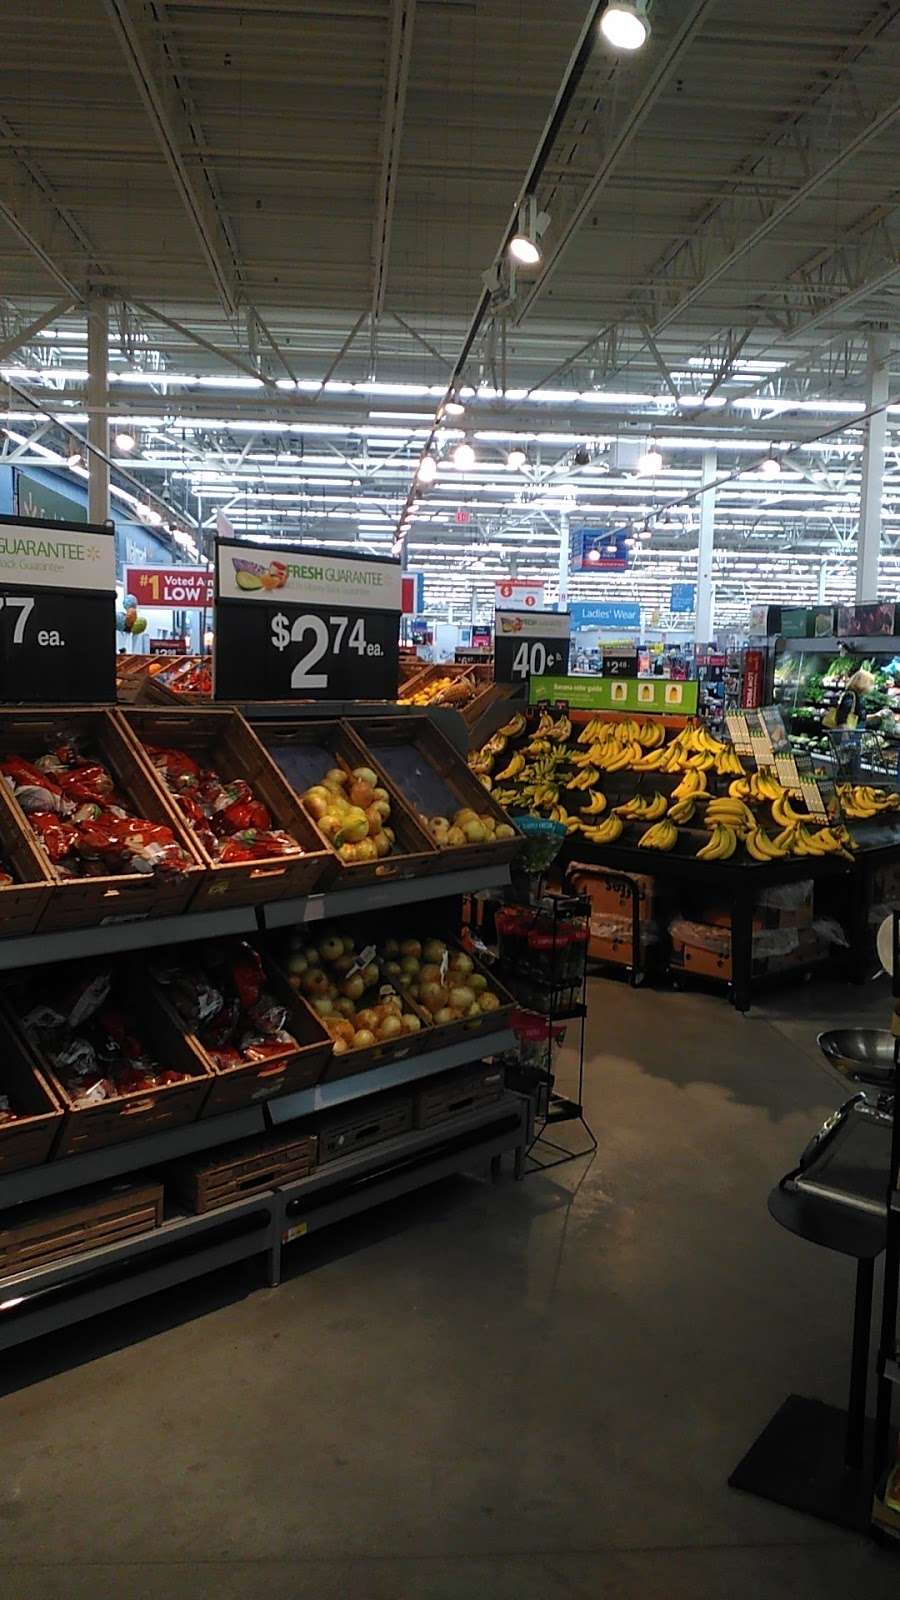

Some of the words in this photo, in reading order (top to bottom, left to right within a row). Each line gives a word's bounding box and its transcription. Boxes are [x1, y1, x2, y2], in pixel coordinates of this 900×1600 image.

[164, 575, 194, 586] Voted
[288, 565, 323, 580] FRESH
[325, 570, 383, 585] GUARANTEE
[139, 575, 160, 601] #1
[164, 587, 201, 602] LOW
[582, 608, 612, 619] Ladies'
[613, 608, 637, 620] Wear
[37, 630, 65, 647] ea.
[366, 642, 385, 657] ea.
